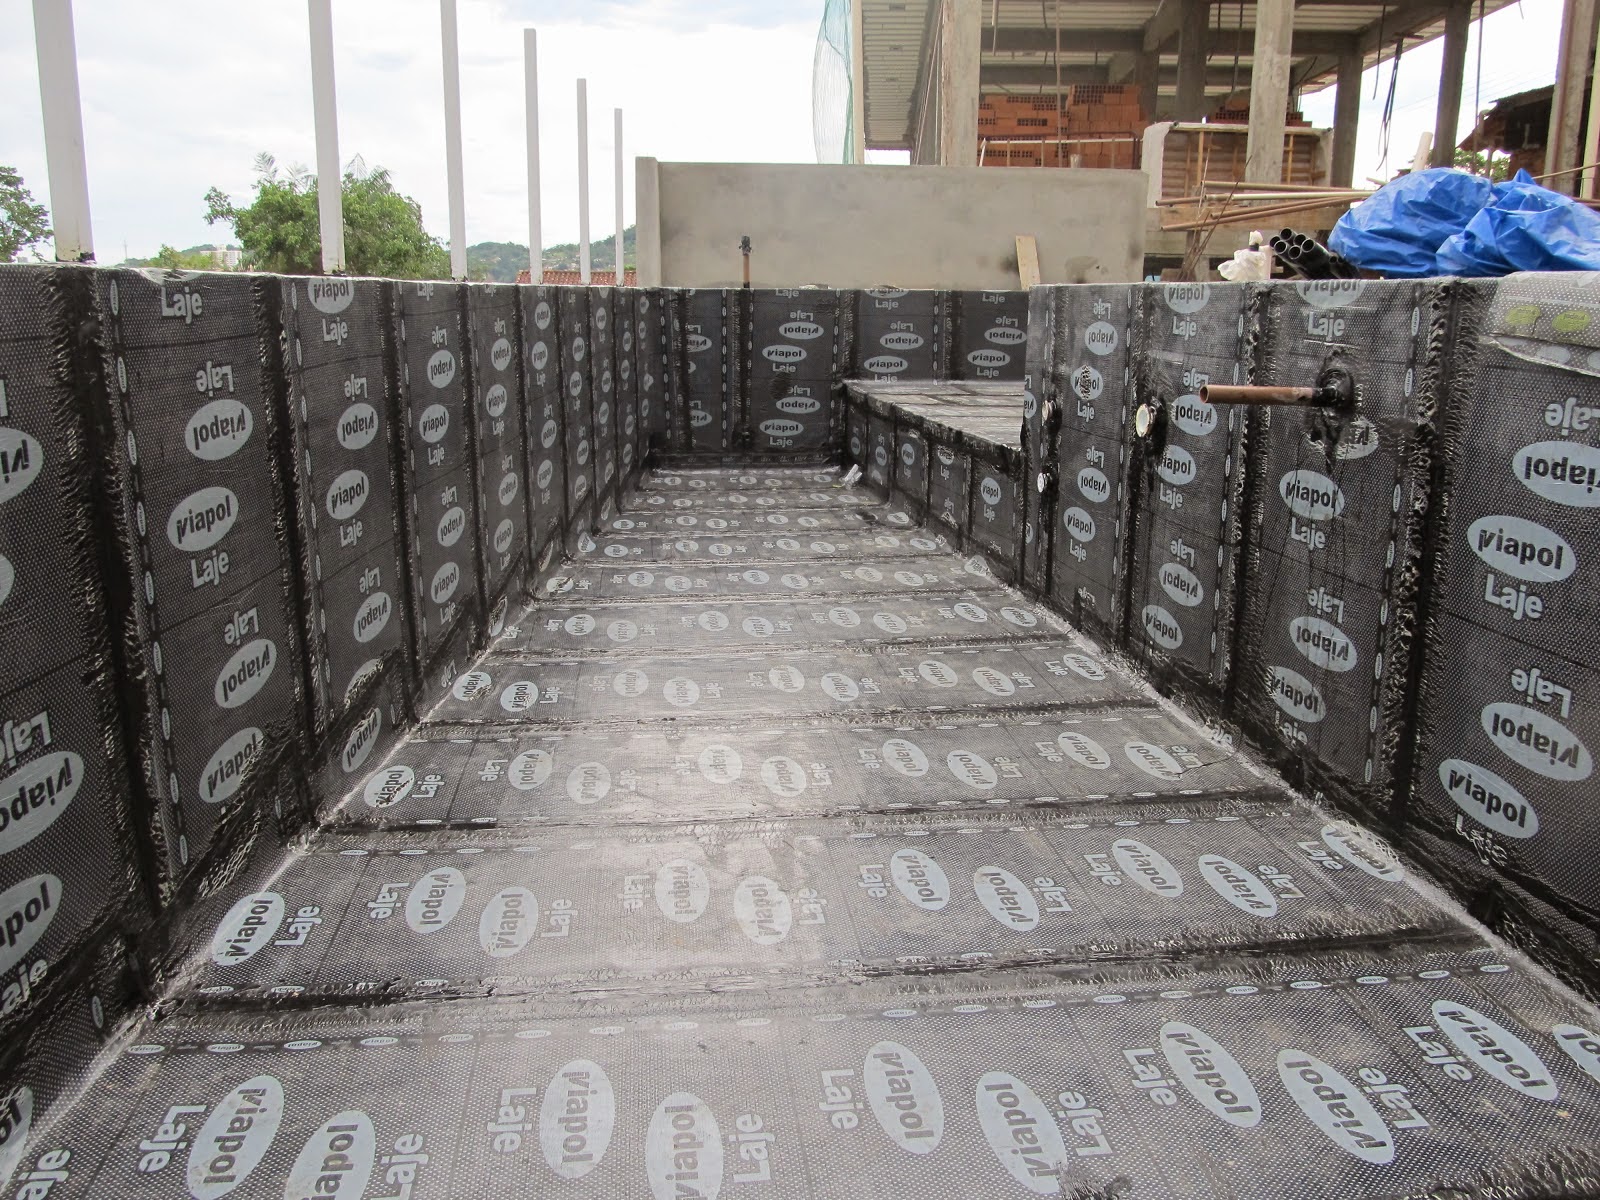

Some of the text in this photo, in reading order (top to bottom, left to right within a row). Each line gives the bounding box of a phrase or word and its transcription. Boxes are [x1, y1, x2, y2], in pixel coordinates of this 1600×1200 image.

[161, 287, 202, 324] Laje
[790, 310, 814, 321] Laje
[875, 300, 899, 310] Laje
[982, 293, 1006, 304] Laje
[1093, 299, 1111, 319] Laje
[322, 317, 348, 345] Laje
[431, 326, 447, 348] Laje
[784, 326, 819, 334] viapol
[890, 321, 914, 331] Laje
[995, 316, 1018, 327] Laje
[1172, 315, 1197, 340] Laje
[1308, 311, 1345, 340] Laje
[767, 349, 802, 358] viapol
[869, 360, 903, 369] viapol
[972, 354, 1006, 362] viapol
[196, 361, 234, 396] Laje
[344, 374, 367, 401] Laje
[976, 367, 1000, 378] Laje
[342, 411, 374, 442] viapol
[423, 412, 446, 441] viapol
[764, 424, 799, 432] viapol
[1077, 401, 1095, 422] Laje
[1175, 403, 1212, 427] viapol
[193, 408, 247, 450] viapol
[769, 437, 793, 448] Laje
[428, 444, 445, 466] Laje
[1086, 446, 1105, 468] Laje
[1162, 455, 1191, 475] iapol
[331, 477, 365, 514] viapol
[1160, 483, 1183, 509] Laje
[1285, 480, 1338, 510] viapol
[176, 495, 232, 544] viapol
[340, 519, 363, 547] Laje
[1067, 513, 1093, 535] viapol
[1291, 517, 1326, 551] Laje
[1070, 539, 1087, 562] Laje
[1171, 538, 1195, 568] Laje
[1478, 528, 1564, 570] viapol
[190, 549, 230, 588] Laje
[359, 566, 380, 594] Laje
[434, 567, 457, 599] viapol
[1163, 570, 1199, 599] viapol
[1307, 587, 1344, 624] Laje
[1485, 573, 1543, 621] Laje
[224, 607, 259, 646] Laje
[357, 597, 387, 637] viapol
[1146, 612, 1178, 642] viapol
[1297, 626, 1349, 662] viapol
[221, 645, 270, 702] viapol
[1511, 668, 1572, 719] Laje
[887, 742, 923, 772] viapol
[1035, 741, 1063, 763] Laje
[1062, 735, 1106, 765] viapol
[1171, 745, 1202, 768] Laje
[1492, 713, 1579, 768] viapol
[477, 759, 508, 782] Laje
[519, 753, 540, 785] viapol
[858, 749, 883, 769] Laje
[953, 754, 993, 785] viapol
[994, 757, 1024, 778] Laje
[0, 757, 73, 832] viapo
[411, 773, 444, 798] Laje
[1449, 769, 1527, 828] viapol
[1084, 853, 1122, 887] Laje
[1116, 844, 1177, 891] viapol
[1296, 841, 1344, 871] Laje
[858, 864, 891, 898] Laje
[897, 854, 943, 903] viapol
[1034, 876, 1073, 913] Laje
[1203, 860, 1272, 911] viapol
[1258, 864, 1306, 900] Laje
[367, 882, 410, 919] Laje
[419, 873, 454, 926] viapol
[981, 871, 1034, 923] viapol
[225, 898, 274, 961] viapol
[275, 905, 321, 946] Laje
[540, 898, 578, 937] Laje
[0, 959, 48, 1018] aje
[1402, 1025, 1473, 1081] Laje
[1438, 1010, 1549, 1088] viapol
[1123, 1048, 1177, 1106] Laje
[1166, 1032, 1254, 1114] viapol
[818, 1069, 867, 1130] Laje
[873, 1052, 935, 1139] viapol
[1284, 1060, 1388, 1149] viapol
[1358, 1067, 1430, 1129] Laje
[487, 1088, 537, 1152] Laje
[562, 1071, 599, 1163] viapol
[984, 1083, 1060, 1178] viapol
[1057, 1091, 1113, 1157] Laje
[138, 1105, 207, 1174] Laje
[203, 1088, 267, 1184] viapol
[729, 1113, 776, 1184] Laje
[16, 1149, 72, 1200] aje
[301, 1124, 359, 1200] iapol
